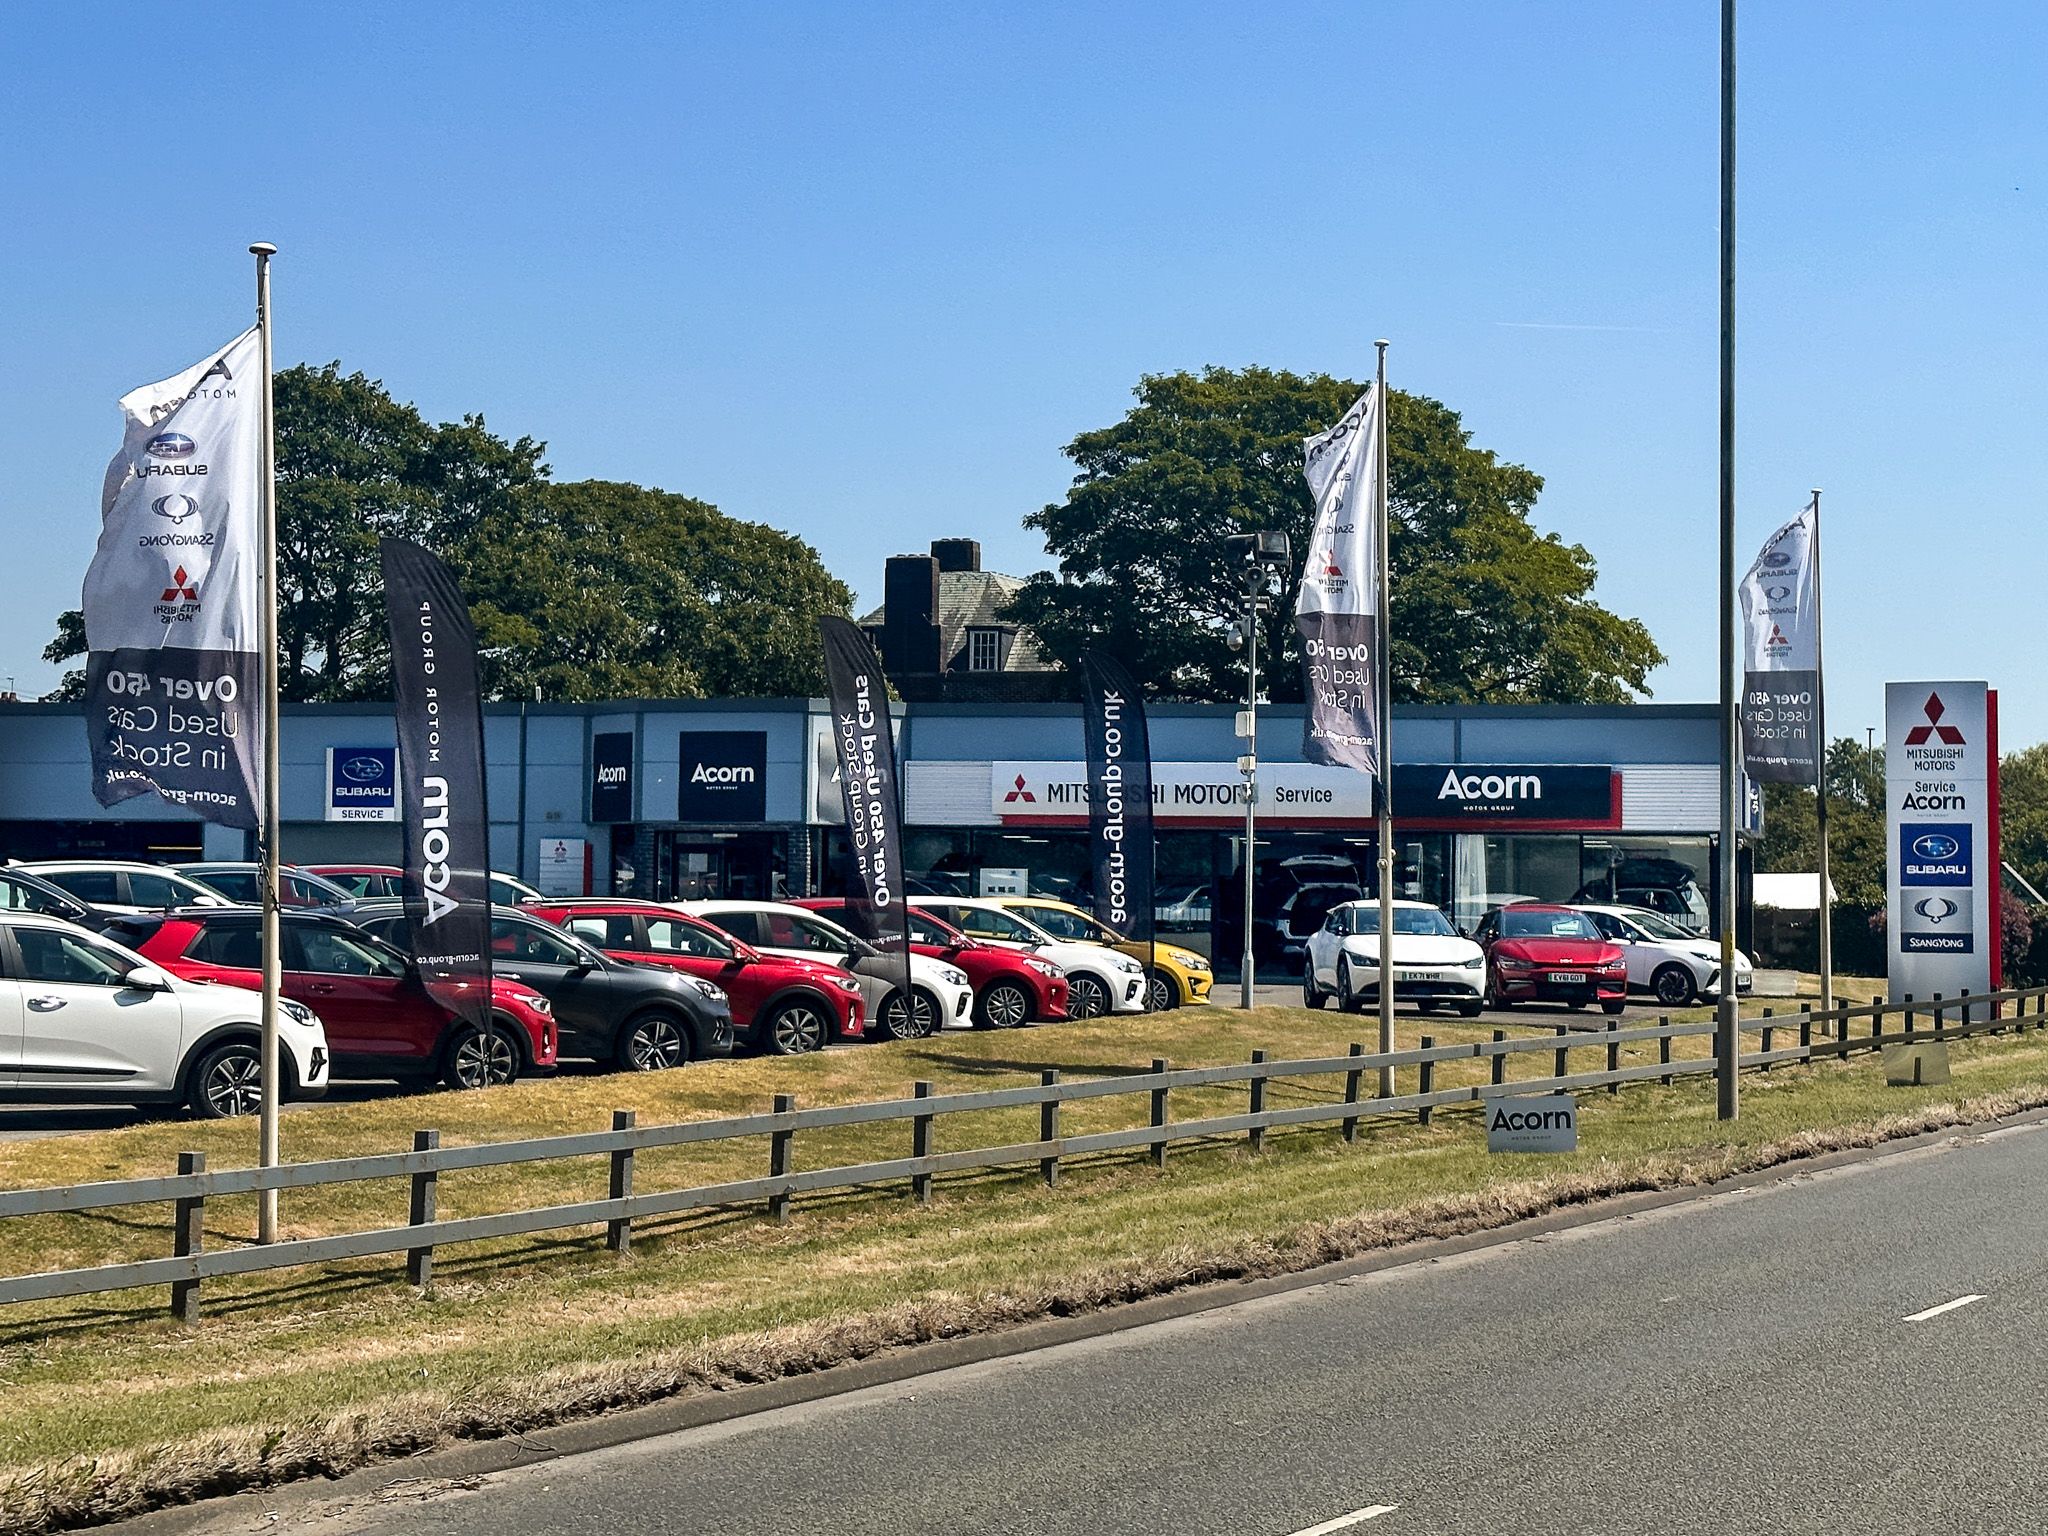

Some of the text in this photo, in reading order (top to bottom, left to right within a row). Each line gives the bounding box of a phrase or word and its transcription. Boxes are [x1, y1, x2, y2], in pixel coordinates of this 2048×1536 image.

[1906, 749, 1964, 759] MITSUBISHI
[598, 763, 626, 783] Acorn
[691, 763, 754, 783] Acorn
[1914, 760, 1956, 771] MOTORS
[336, 787, 391, 796] SUBARU
[1438, 769, 1541, 799] Acorn
[1915, 781, 1956, 793] Service
[1175, 785, 1242, 804] MOTOR
[1276, 787, 1332, 803] Service
[1902, 792, 1966, 810] Acorn
[342, 810, 384, 818] SERVICE
[1906, 865, 1966, 875] SUBARU
[1491, 1108, 1571, 1131] Acorn
